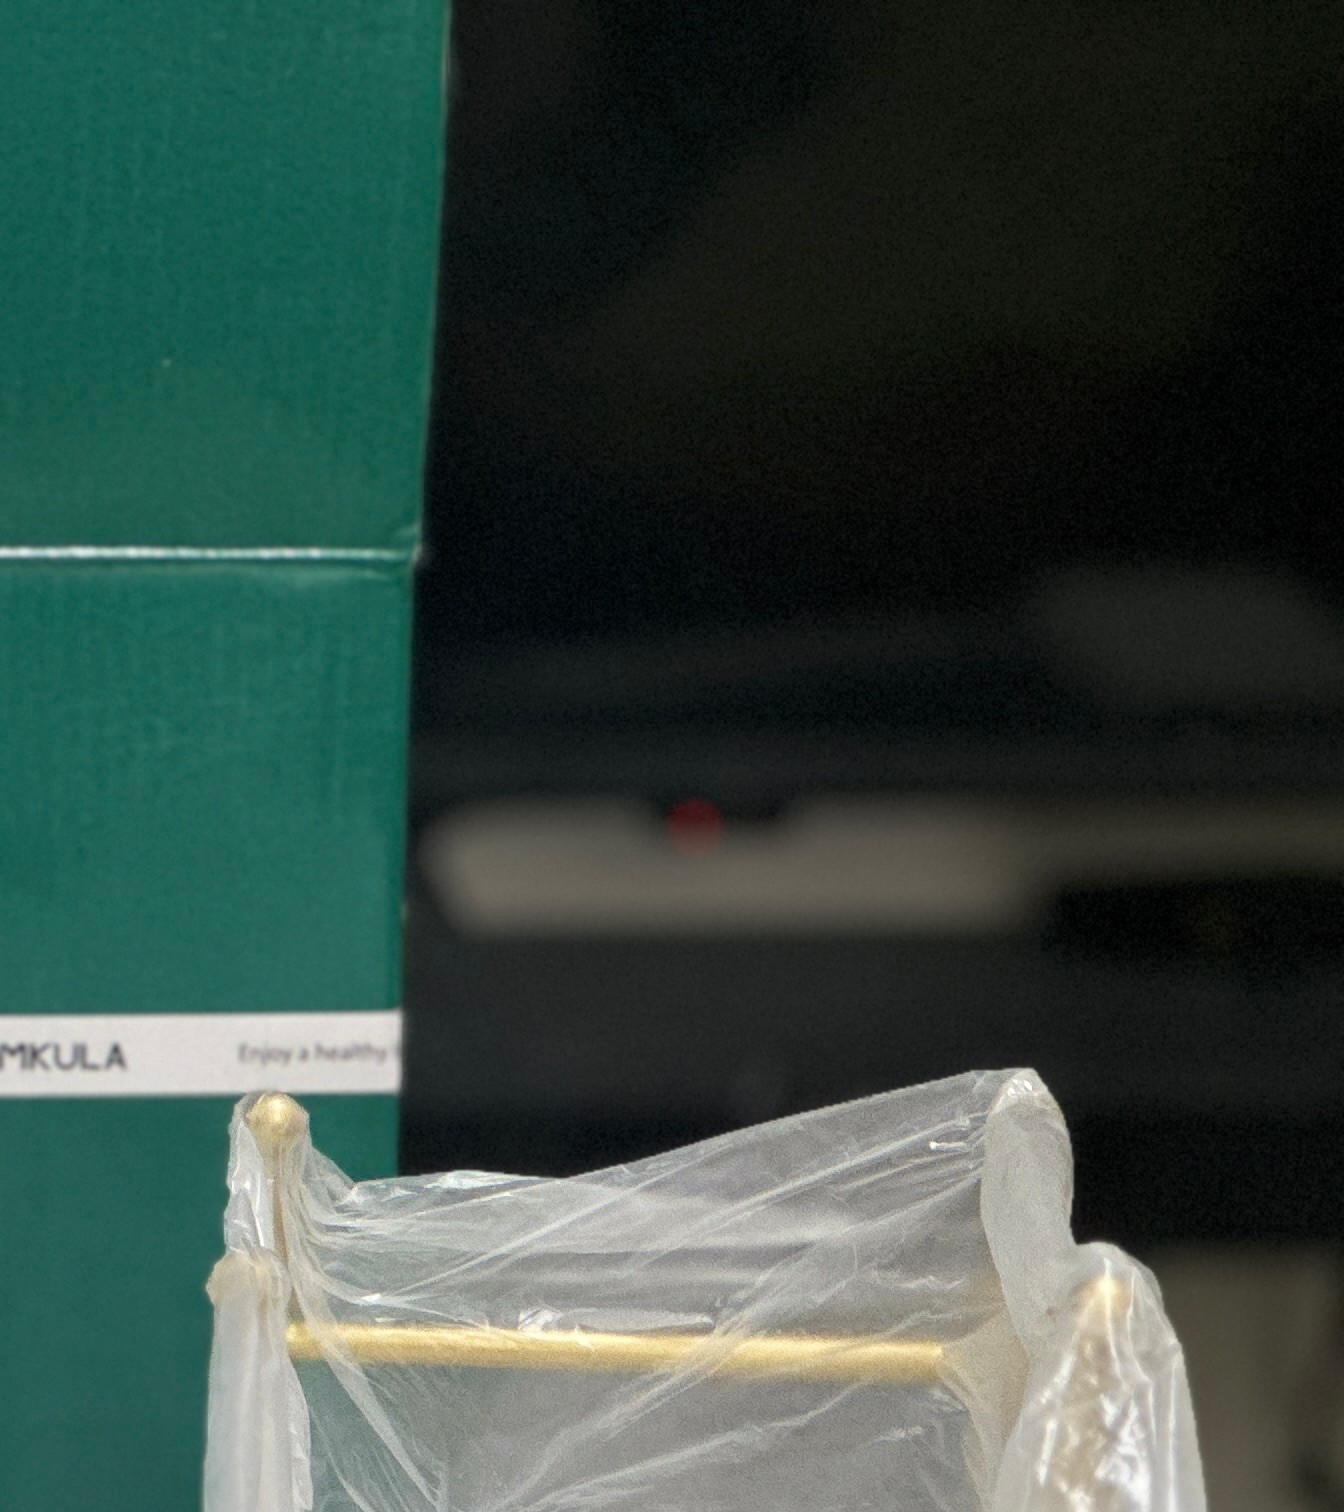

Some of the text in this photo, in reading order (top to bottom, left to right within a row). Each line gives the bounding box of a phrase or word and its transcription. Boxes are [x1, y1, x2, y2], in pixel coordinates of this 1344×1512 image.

[238, 1042, 291, 1068] Enjoy
[298, 1048, 310, 1063] a
[314, 1042, 387, 1067] healthy
